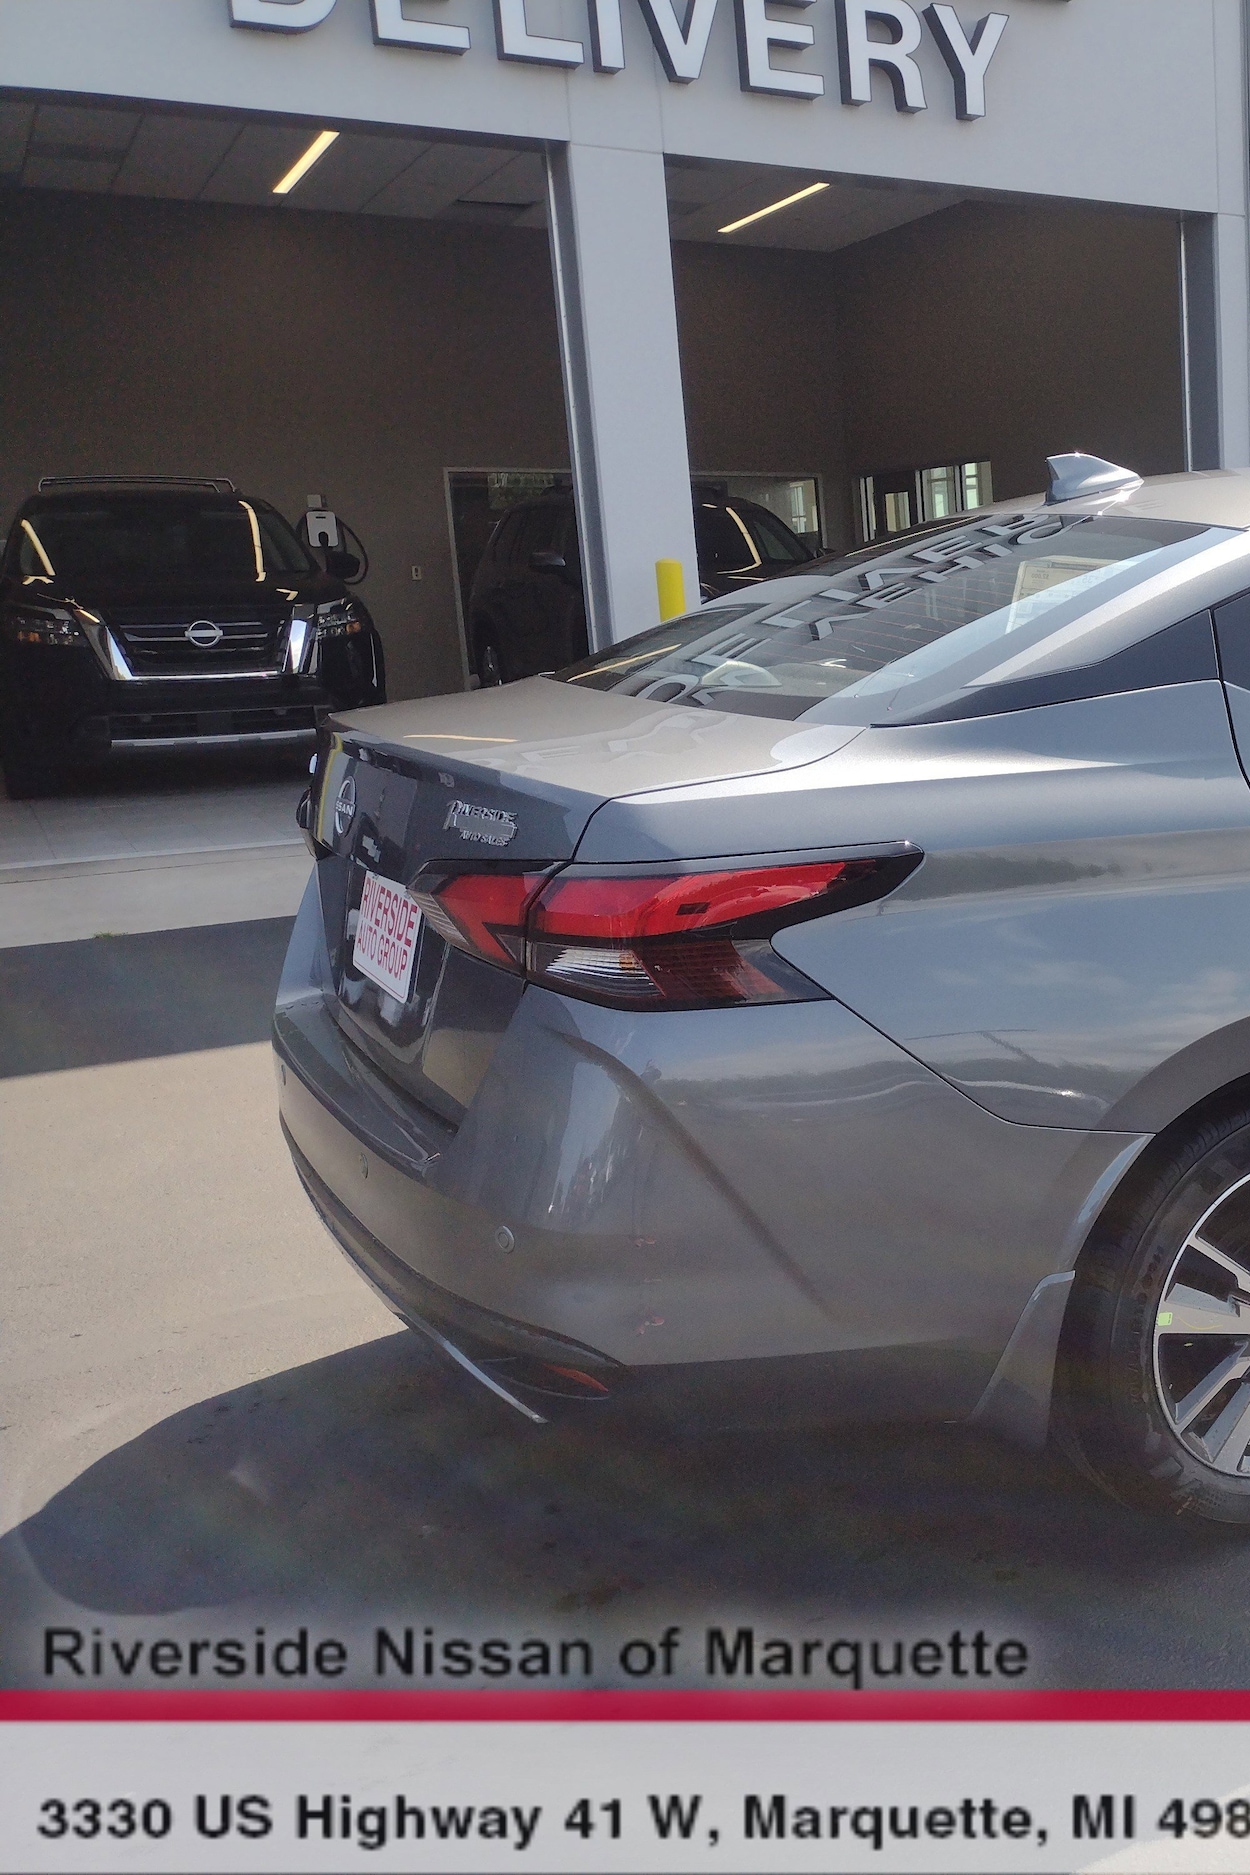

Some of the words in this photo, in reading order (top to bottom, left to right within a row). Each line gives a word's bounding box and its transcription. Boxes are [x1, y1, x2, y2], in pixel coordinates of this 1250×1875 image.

[229, 0, 1010, 121] ELIVERY
[361, 876, 418, 948] RIVERSIDE
[356, 920, 378, 961] AUTO
[376, 934, 408, 981] GROUP
